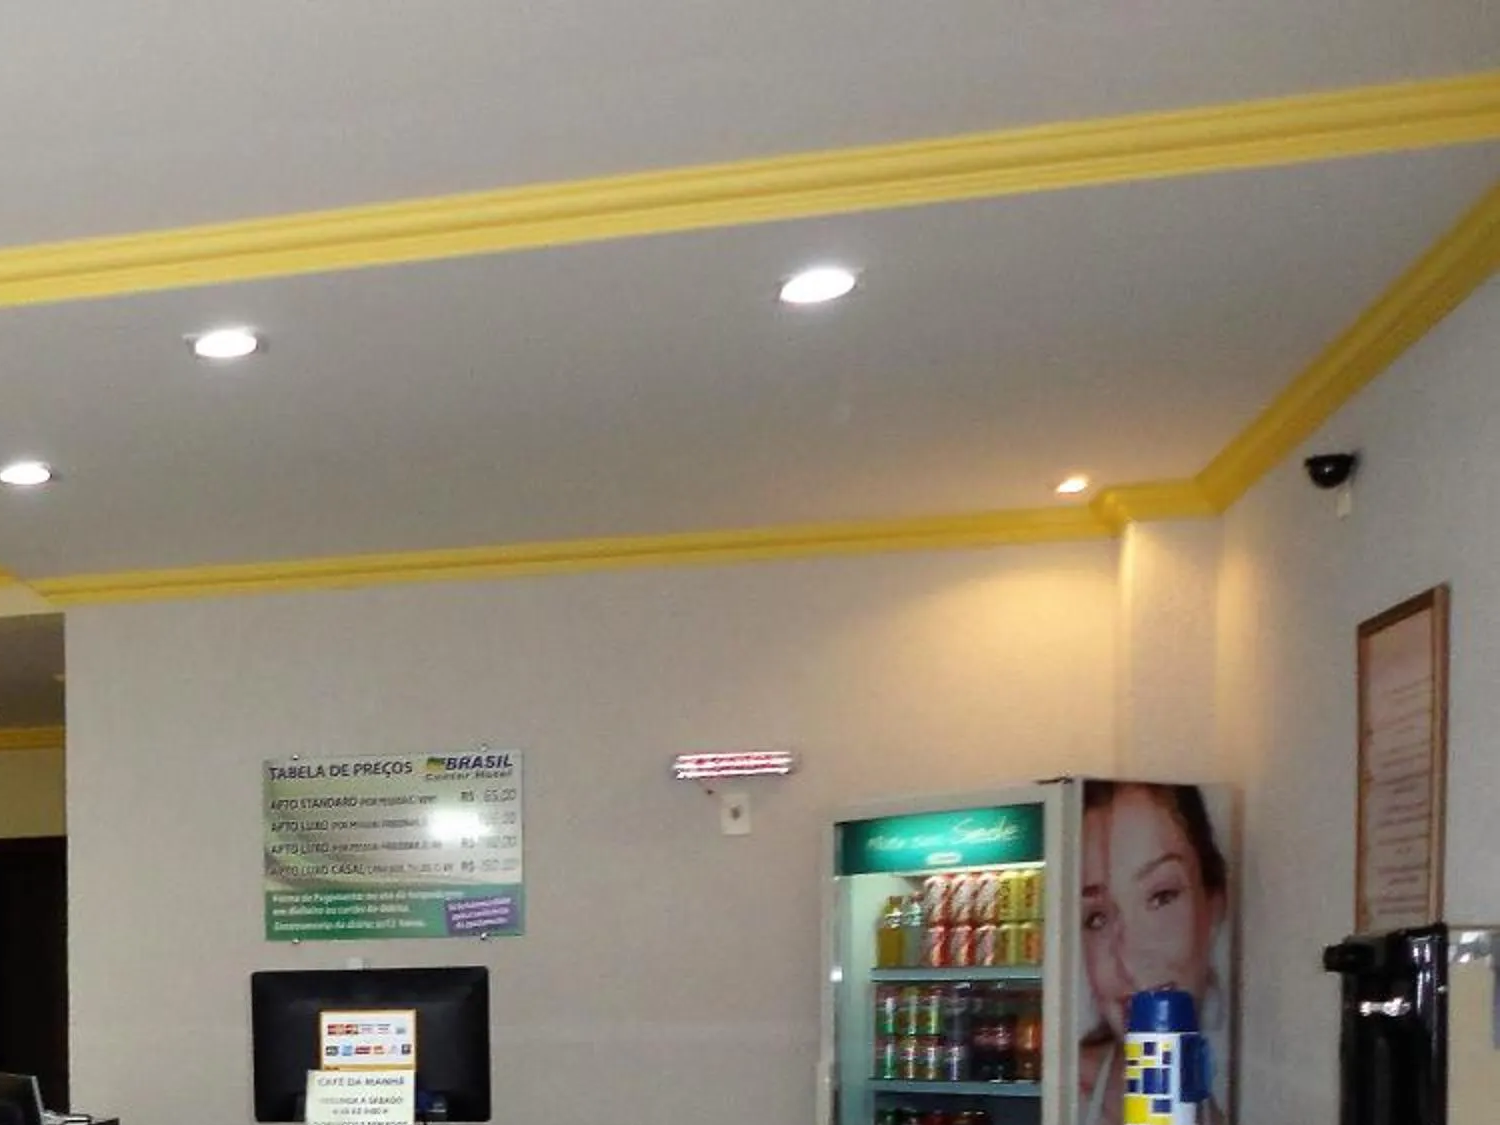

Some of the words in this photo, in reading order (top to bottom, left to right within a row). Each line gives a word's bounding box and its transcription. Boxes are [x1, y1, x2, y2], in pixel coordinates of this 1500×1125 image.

[268, 764, 326, 781] TABELA
[329, 763, 350, 777] DE
[353, 761, 413, 779] PREÇOS
[444, 753, 514, 771] BRASIL
